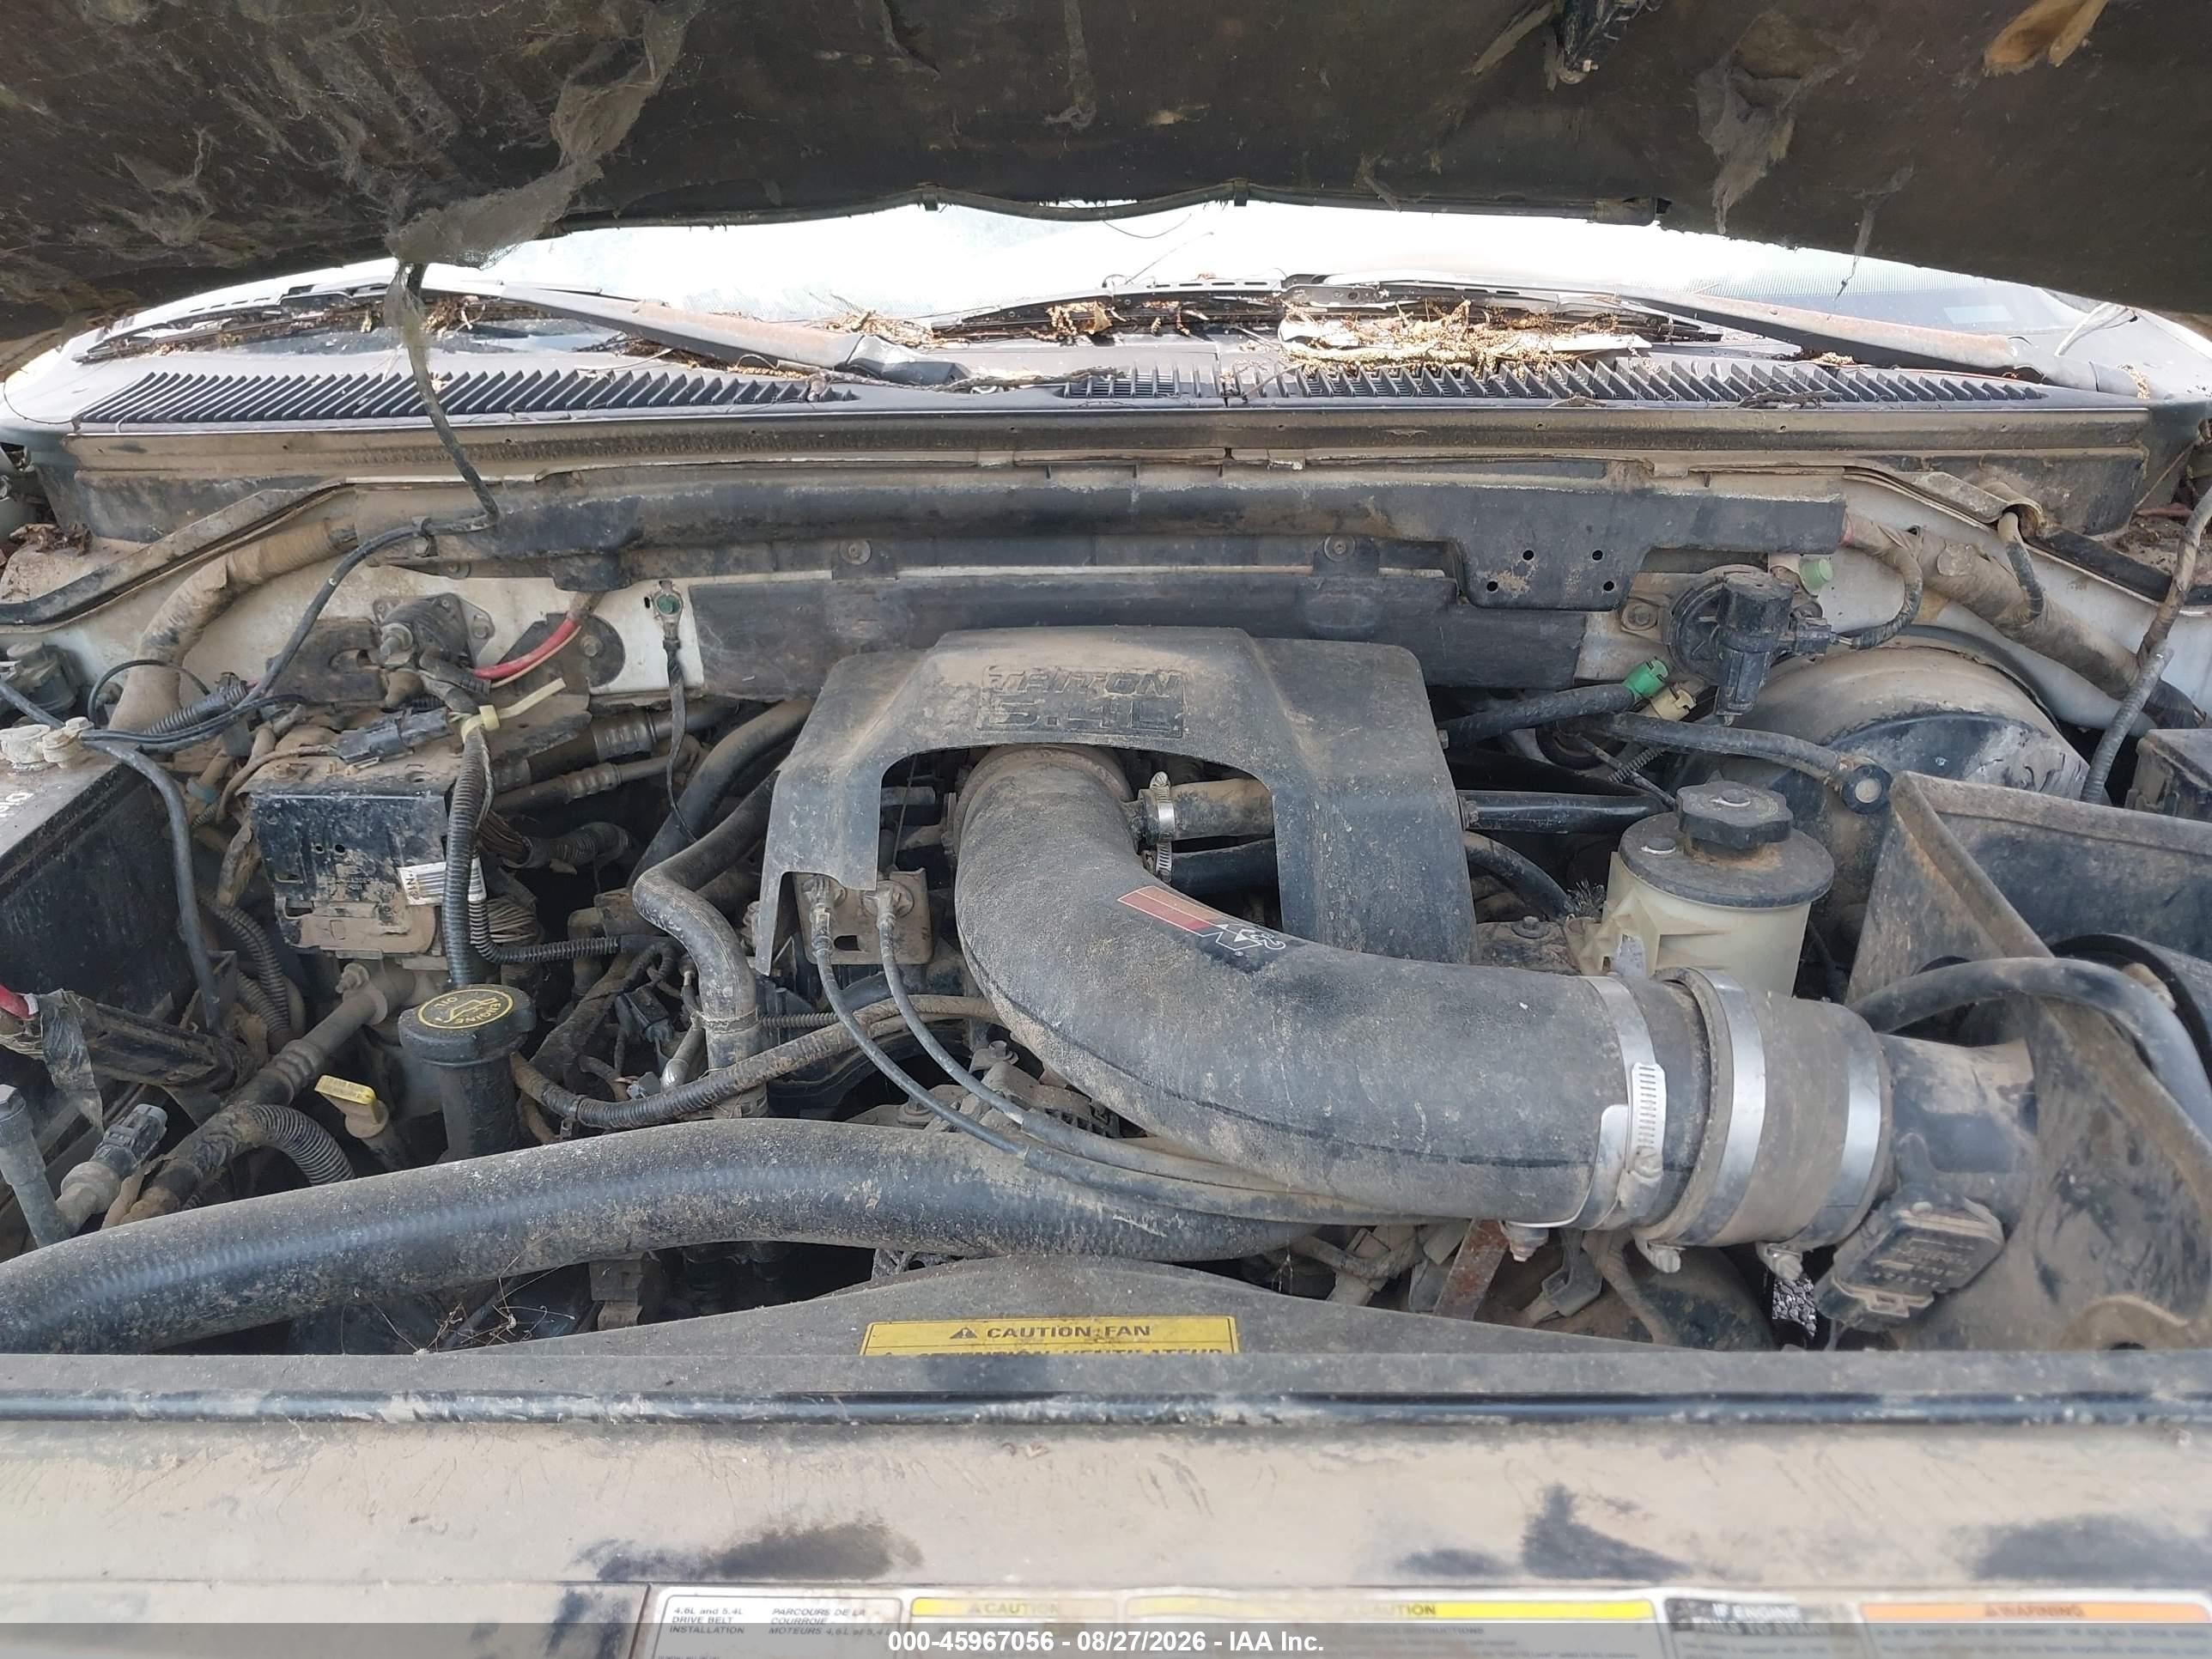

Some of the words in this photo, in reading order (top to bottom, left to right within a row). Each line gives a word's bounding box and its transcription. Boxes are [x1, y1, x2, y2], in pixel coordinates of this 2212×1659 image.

[988, 666, 1182, 696] TRITON
[988, 698, 1179, 732] 5.4L
[434, 997, 459, 1009] OIL
[454, 1002, 502, 1024] ENGINE
[986, 1325, 1091, 1340] CAUTION
[1104, 1324, 1152, 1337] FAN
[699, 1607, 719, 1615] and
[721, 1607, 744, 1615] 5.4L
[771, 1607, 831, 1616] PARCOURS
[984, 1602, 1059, 1614] CAUTION
[672, 1615, 706, 1624] DRIVE
[707, 1615, 734, 1624] BELT
[669, 1626, 745, 1635] INSTALLATION
[769, 1626, 822, 1636] MOTEURS
